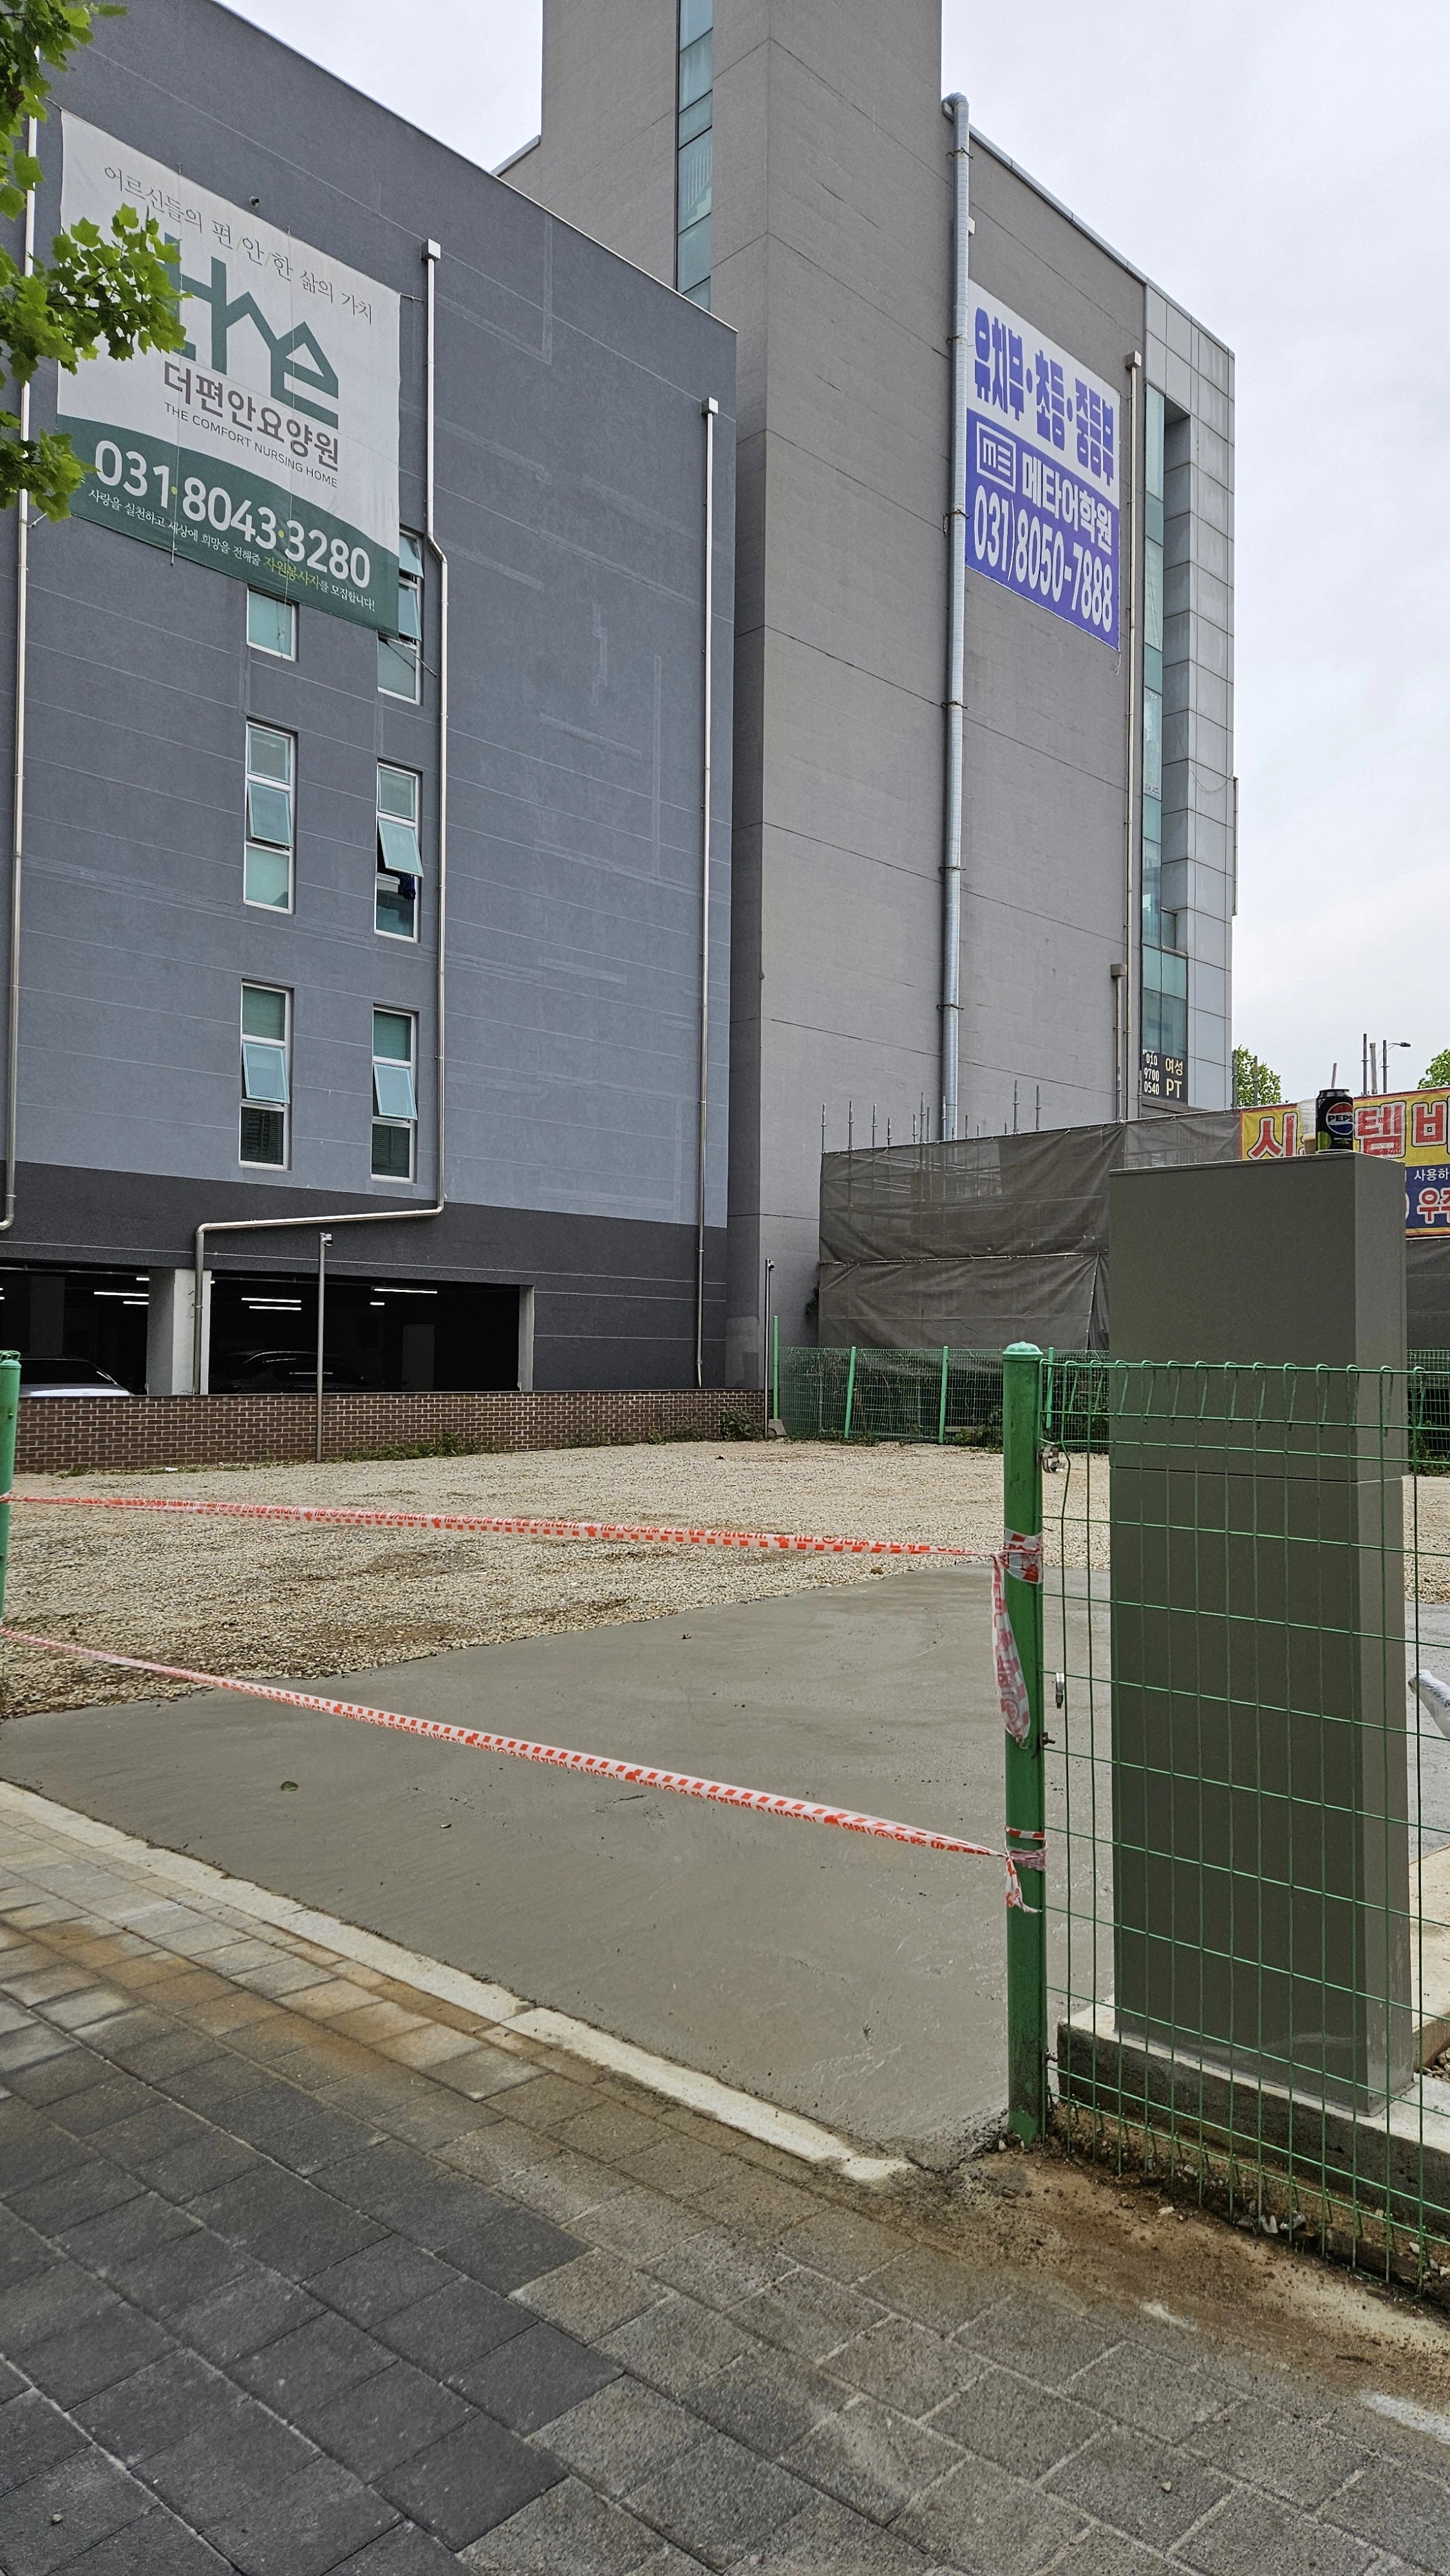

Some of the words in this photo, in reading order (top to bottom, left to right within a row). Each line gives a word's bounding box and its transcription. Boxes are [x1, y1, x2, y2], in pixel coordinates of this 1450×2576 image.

[104, 167, 202, 233] 어르신들의
[299, 270, 333, 304] 삶의
[341, 292, 372, 325] 가치
[164, 361, 338, 471] 더편안요양원
[164, 402, 189, 421] THE
[193, 415, 252, 447] COMFORT
[254, 442, 303, 473] NURSING
[306, 466, 338, 488] HOME
[1022, 451, 1112, 555] 메타어학원
[88, 489, 122, 511] 사랑을
[124, 502, 165, 527] 실천하고
[167, 521, 198, 542] 세상에
[200, 534, 231, 554] 희망을
[232, 546, 261, 566] 전해줄
[263, 556, 329, 592] 자원봉사자를
[330, 585, 375, 612] 모집합니다!
[974, 484, 1113, 632] 031)8050-7888
[1144, 1067, 1160, 1082] 9700
[1144, 1081, 1160, 1095] 0540
[1146, 1053, 1158, 1066] 010
[1165, 1057, 1183, 1076] 여성
[1166, 1078, 1183, 1099] PT
[1247, 1100, 1450, 1159] 시템비
